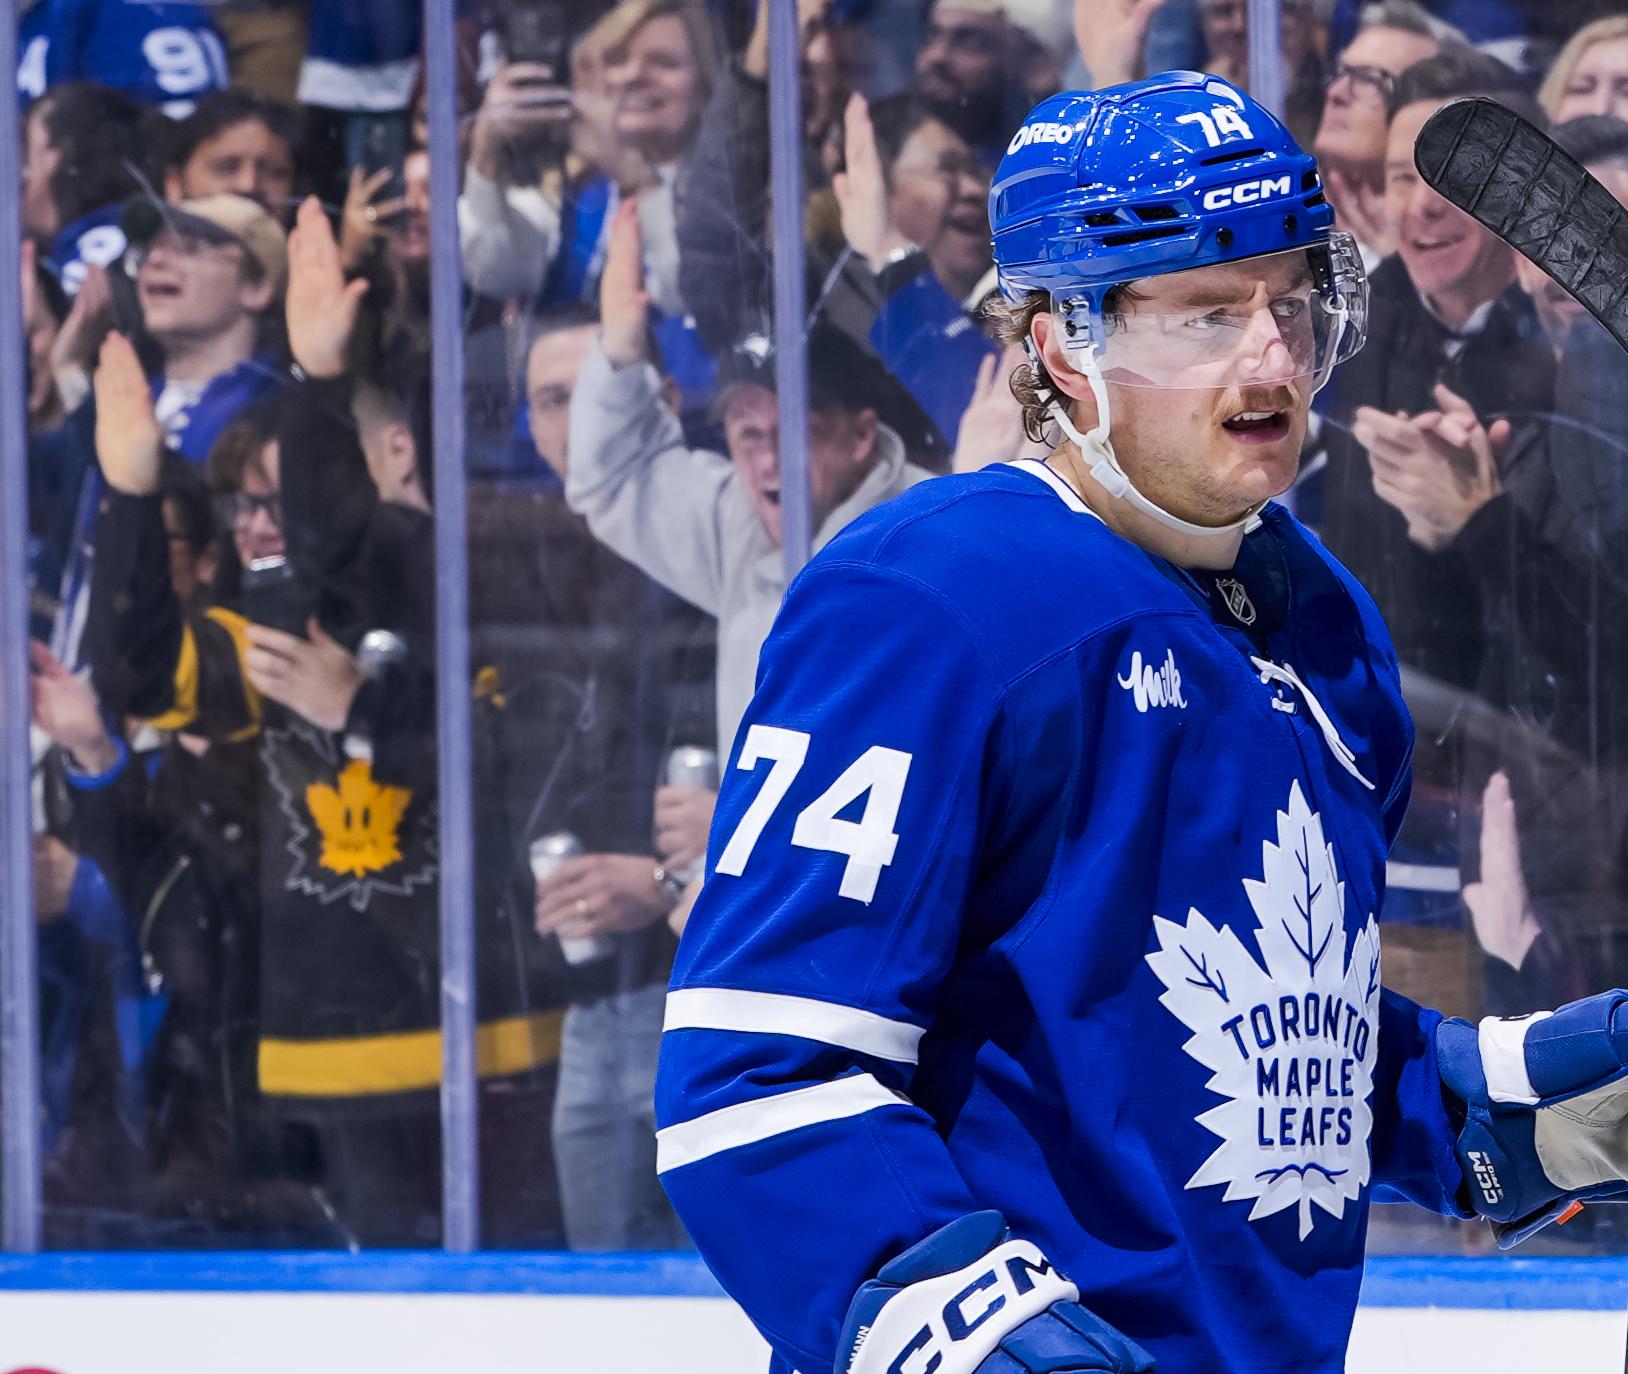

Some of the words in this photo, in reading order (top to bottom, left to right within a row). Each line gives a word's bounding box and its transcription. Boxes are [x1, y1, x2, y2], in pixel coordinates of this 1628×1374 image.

[1006, 122, 1073, 156] OREO
[1175, 104, 1254, 147] 74
[1203, 176, 1292, 211] CCM
[1117, 648, 1188, 713] Milk
[715, 724, 913, 907] 74
[1220, 992, 1370, 1063] TORONTO
[1256, 1058, 1354, 1097] MAPLE
[1257, 1106, 1353, 1147] LEAFS
[1467, 1151, 1499, 1204] CCM
